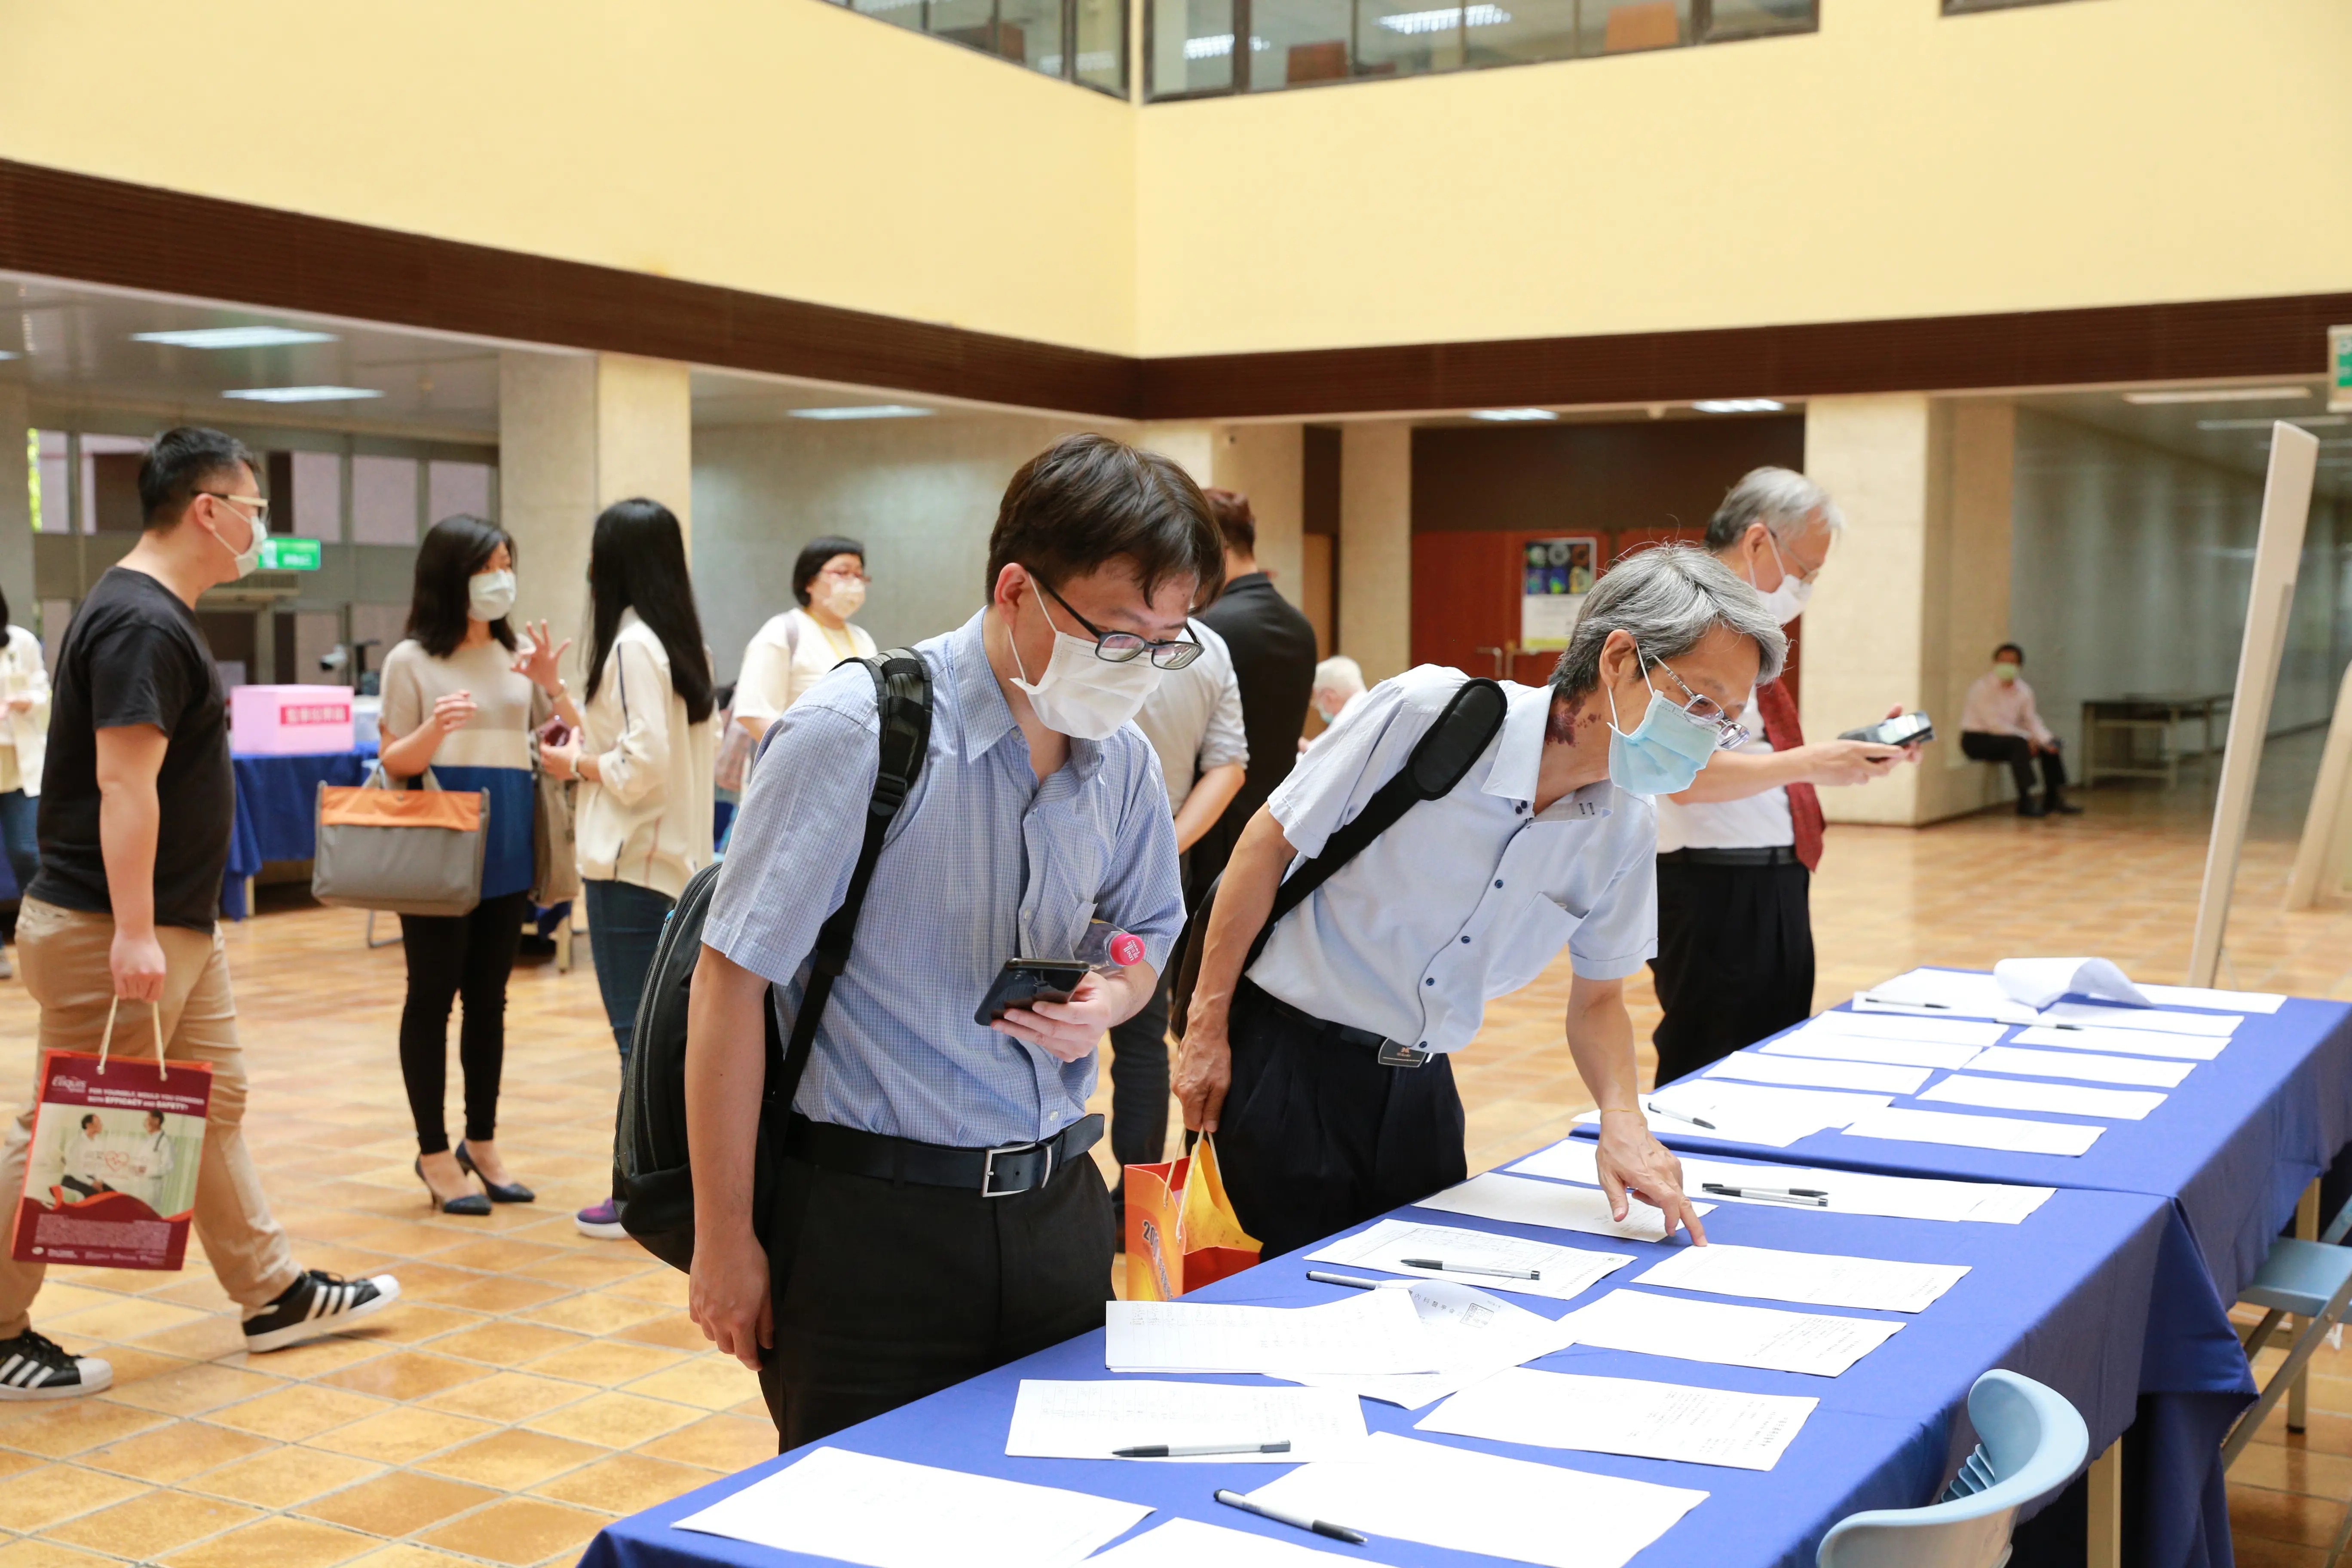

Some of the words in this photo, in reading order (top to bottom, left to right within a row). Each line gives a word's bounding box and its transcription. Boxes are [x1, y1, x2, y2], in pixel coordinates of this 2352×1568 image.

[1408, 1290, 1464, 1317] 內科醫學會
